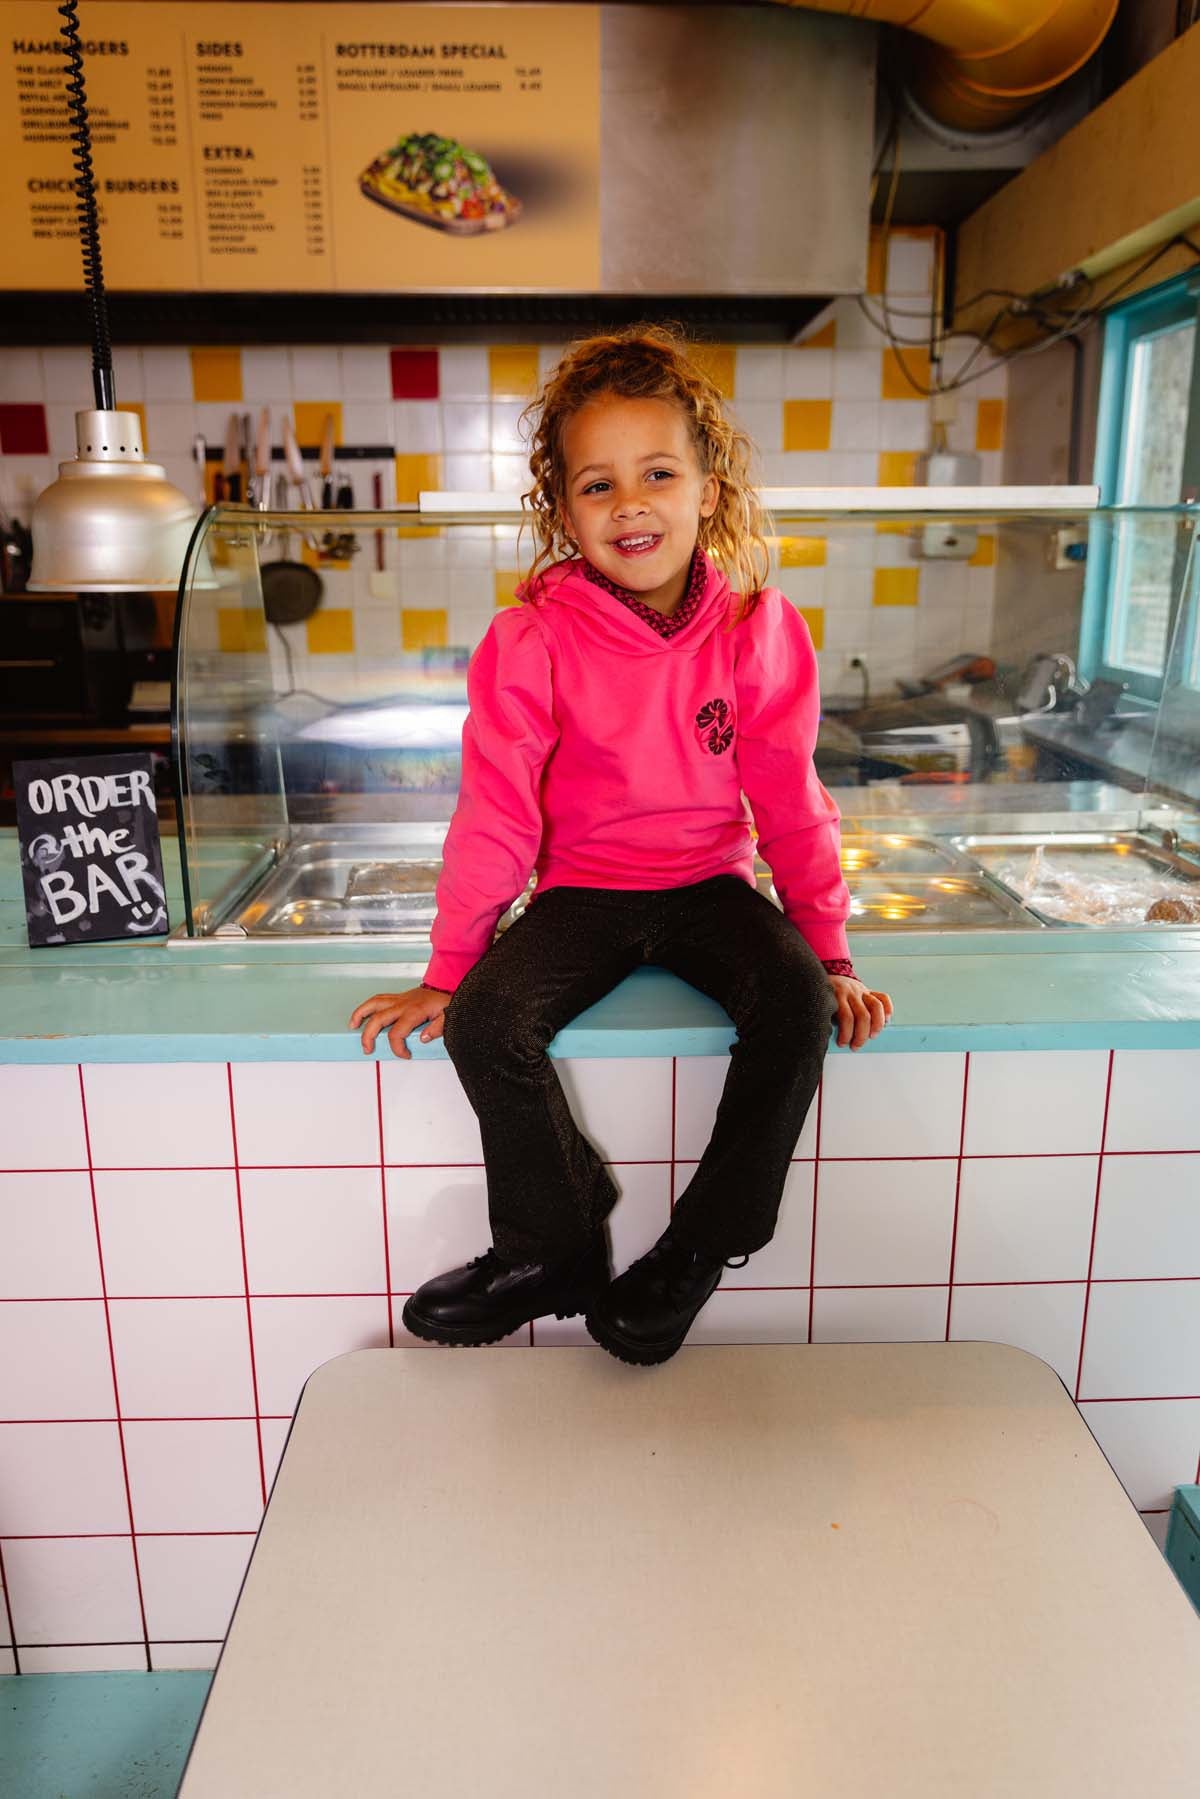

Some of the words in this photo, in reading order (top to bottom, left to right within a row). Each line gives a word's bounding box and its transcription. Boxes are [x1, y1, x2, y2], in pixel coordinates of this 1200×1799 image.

[196, 41, 243, 57] SIDES
[336, 43, 436, 58] ROTTERDAM
[440, 43, 507, 59] SPECIAL
[203, 146, 255, 160] EXTRA
[28, 178, 100, 193] CHICK
[106, 178, 179, 194] BURGERS
[28, 770, 156, 817] ORDER
[40, 852, 165, 925] BAR
